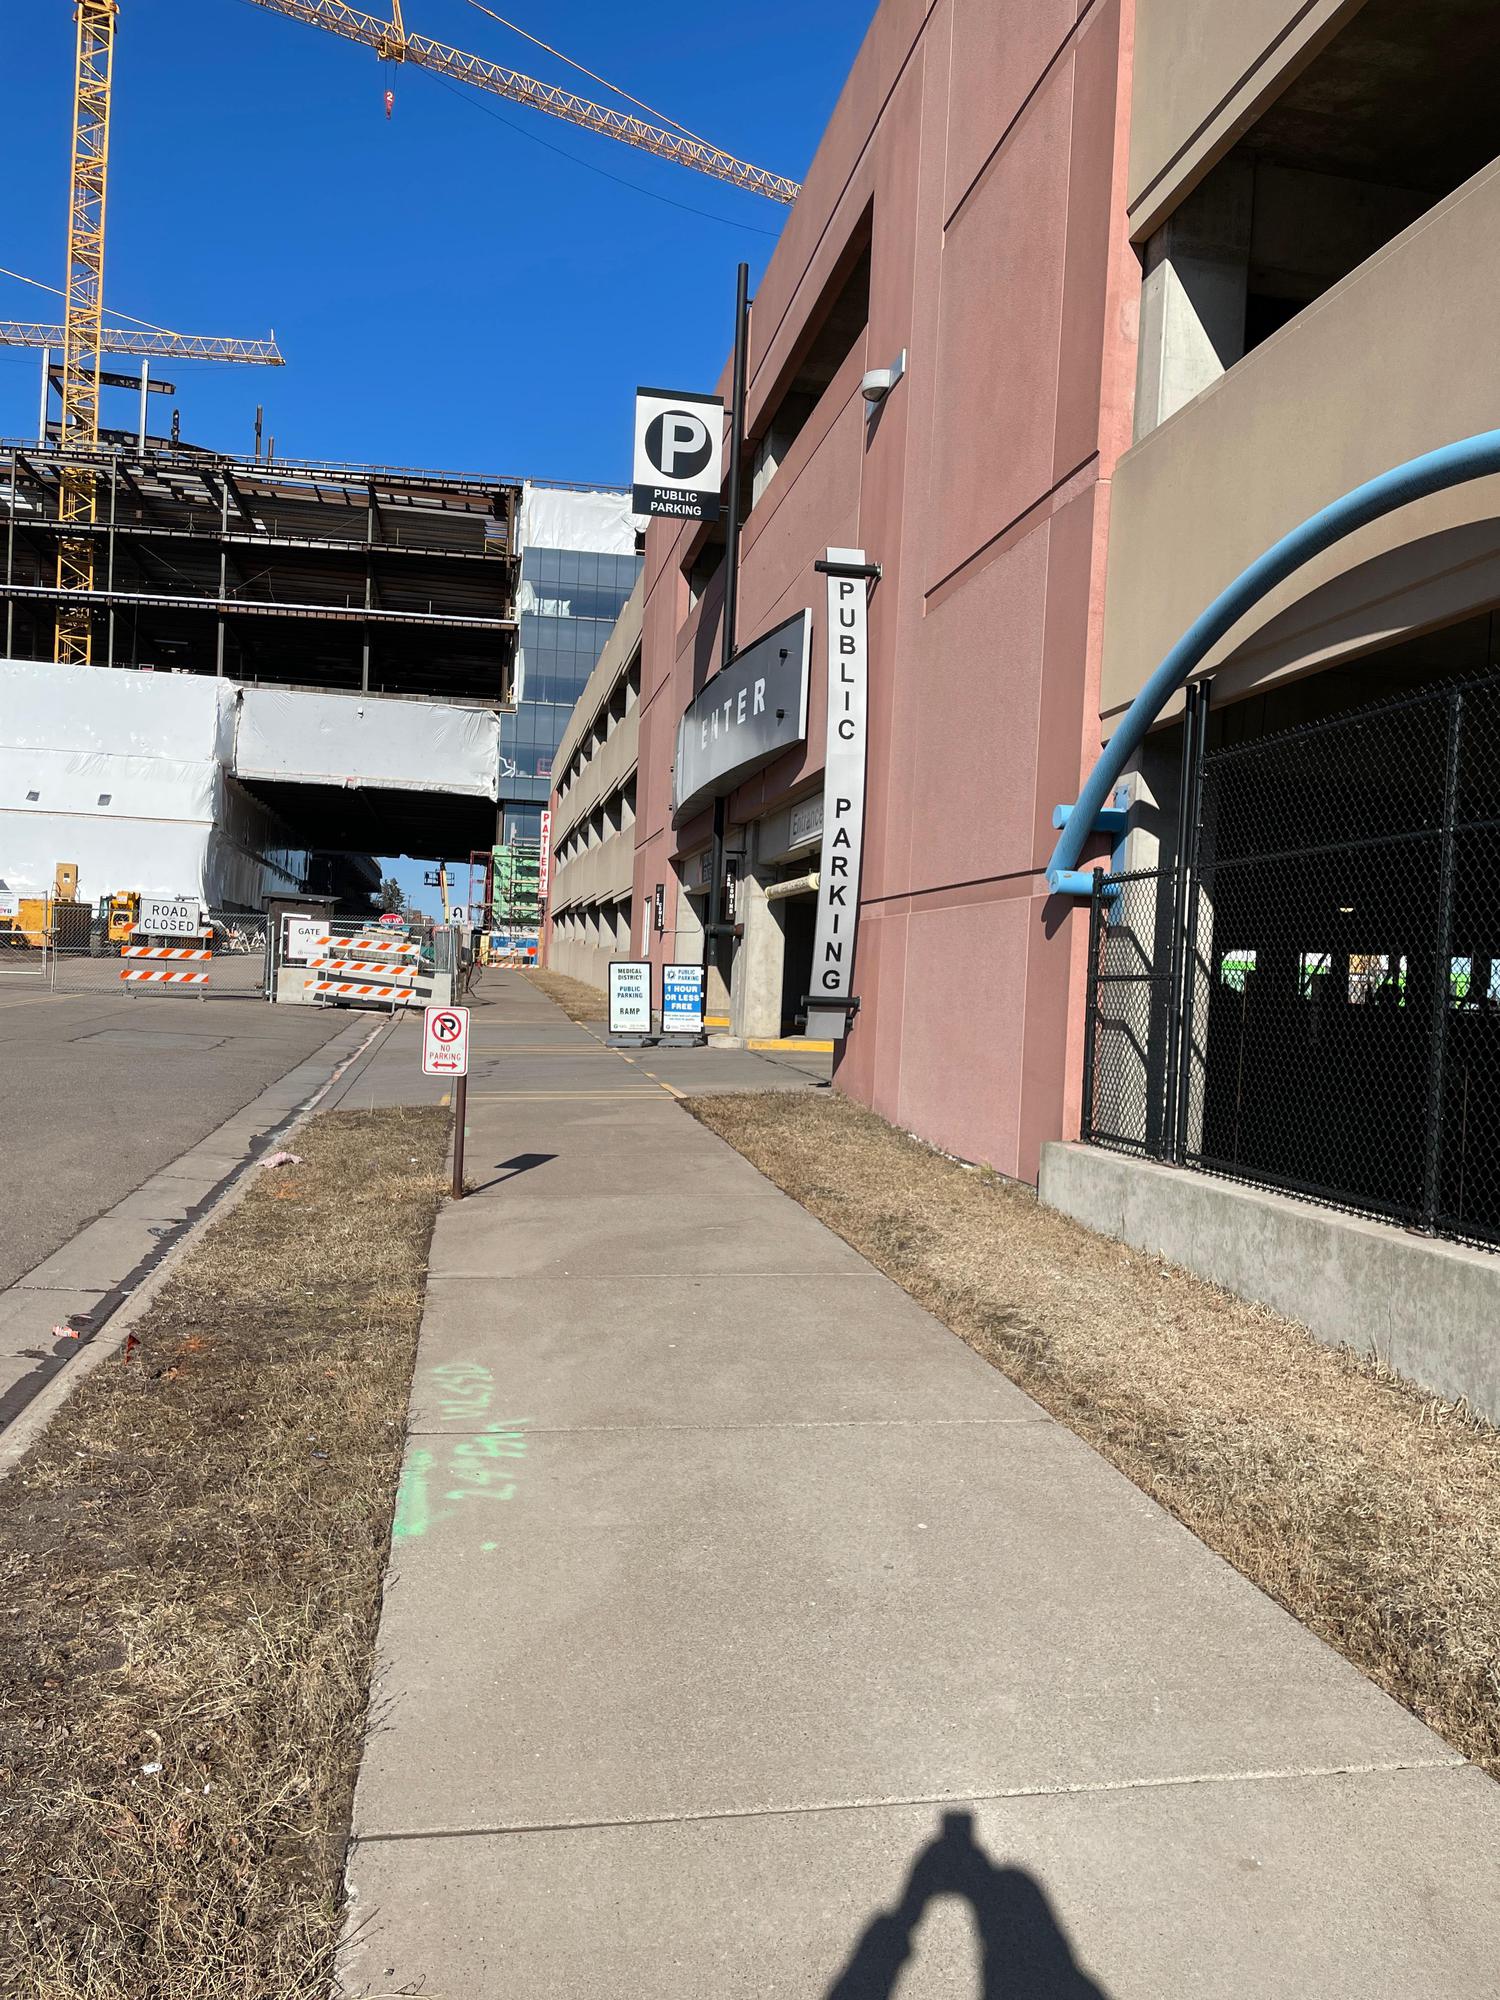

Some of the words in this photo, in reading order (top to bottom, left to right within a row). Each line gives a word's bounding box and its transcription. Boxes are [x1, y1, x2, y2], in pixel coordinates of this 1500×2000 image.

[386, 92, 393, 101] 2
[661, 413, 707, 473] P
[654, 489, 698, 502] PUBLIC
[650, 502, 702, 516] PARKING
[838, 581, 856, 741] PUBLIC
[701, 677, 766, 752] ENTER
[540, 813, 549, 887] PATIENT
[821, 797, 852, 990] PARKING
[152, 905, 188, 917] ROAD
[144, 918, 194, 931] CLOSED
[678, 994, 700, 1002] LESS
[440, 1044, 451, 1053] NO
[429, 1052, 462, 1061] PARKING
